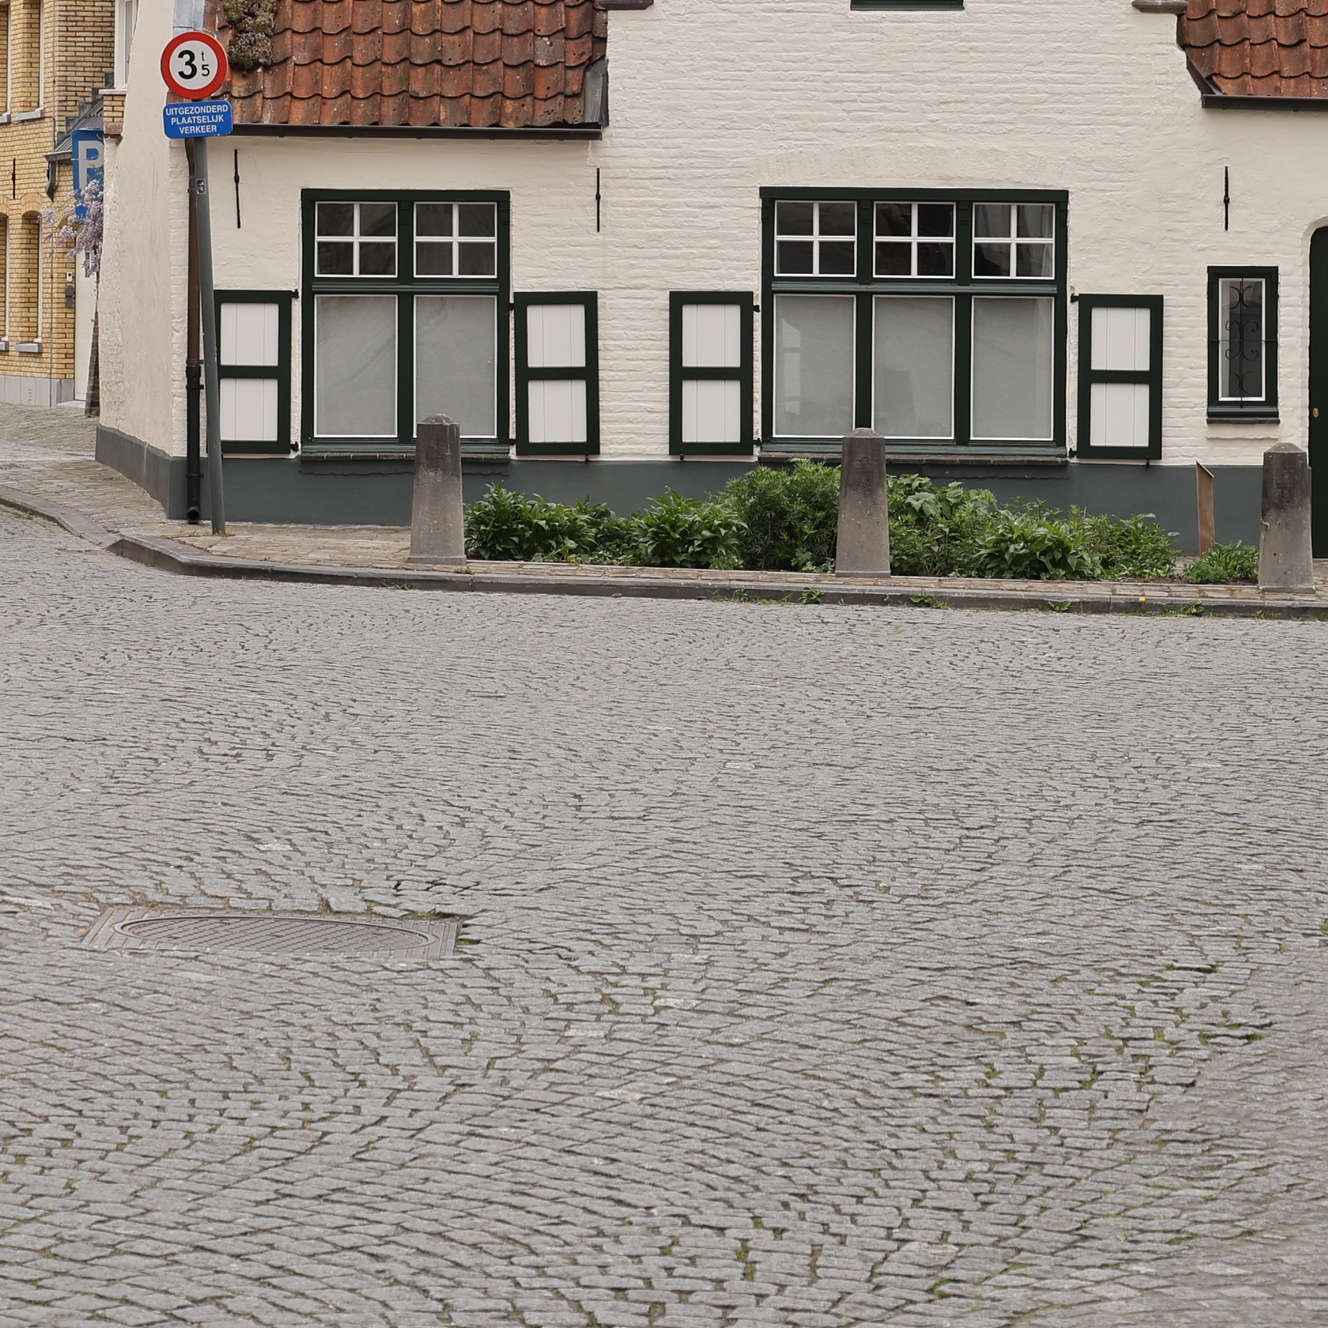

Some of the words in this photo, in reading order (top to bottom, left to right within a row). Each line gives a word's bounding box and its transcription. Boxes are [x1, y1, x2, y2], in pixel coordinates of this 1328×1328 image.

[178, 50, 197, 79] 3
[201, 64, 210, 77] 5
[165, 104, 229, 116] UITGEZONDERD
[170, 114, 224, 125] PLAATSELIJK
[179, 125, 217, 134] VERKEER
[78, 140, 104, 192] P
